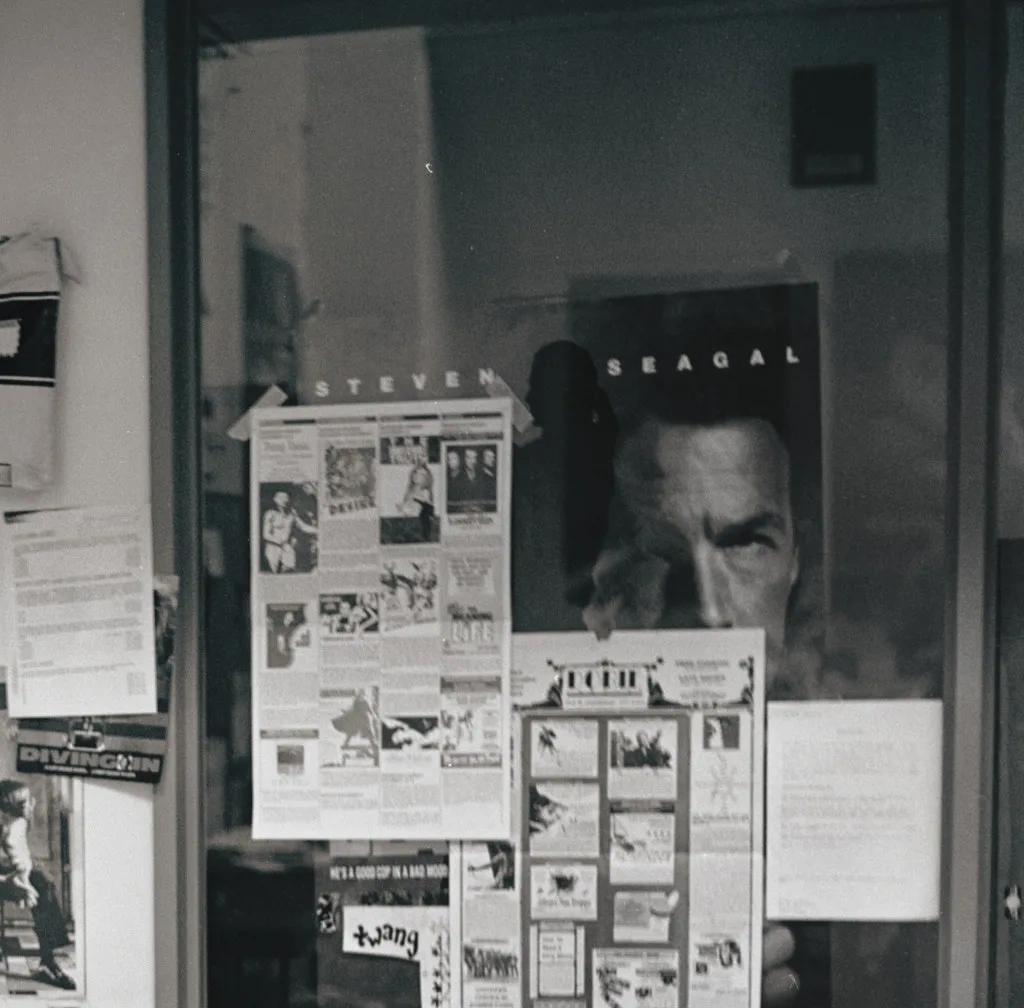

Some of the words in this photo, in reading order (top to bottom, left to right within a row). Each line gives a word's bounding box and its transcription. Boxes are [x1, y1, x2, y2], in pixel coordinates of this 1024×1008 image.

[606, 346, 800, 376] SEAGAL
[315, 368, 495, 397] STEVEN
[353, 923, 419, 959] twang
